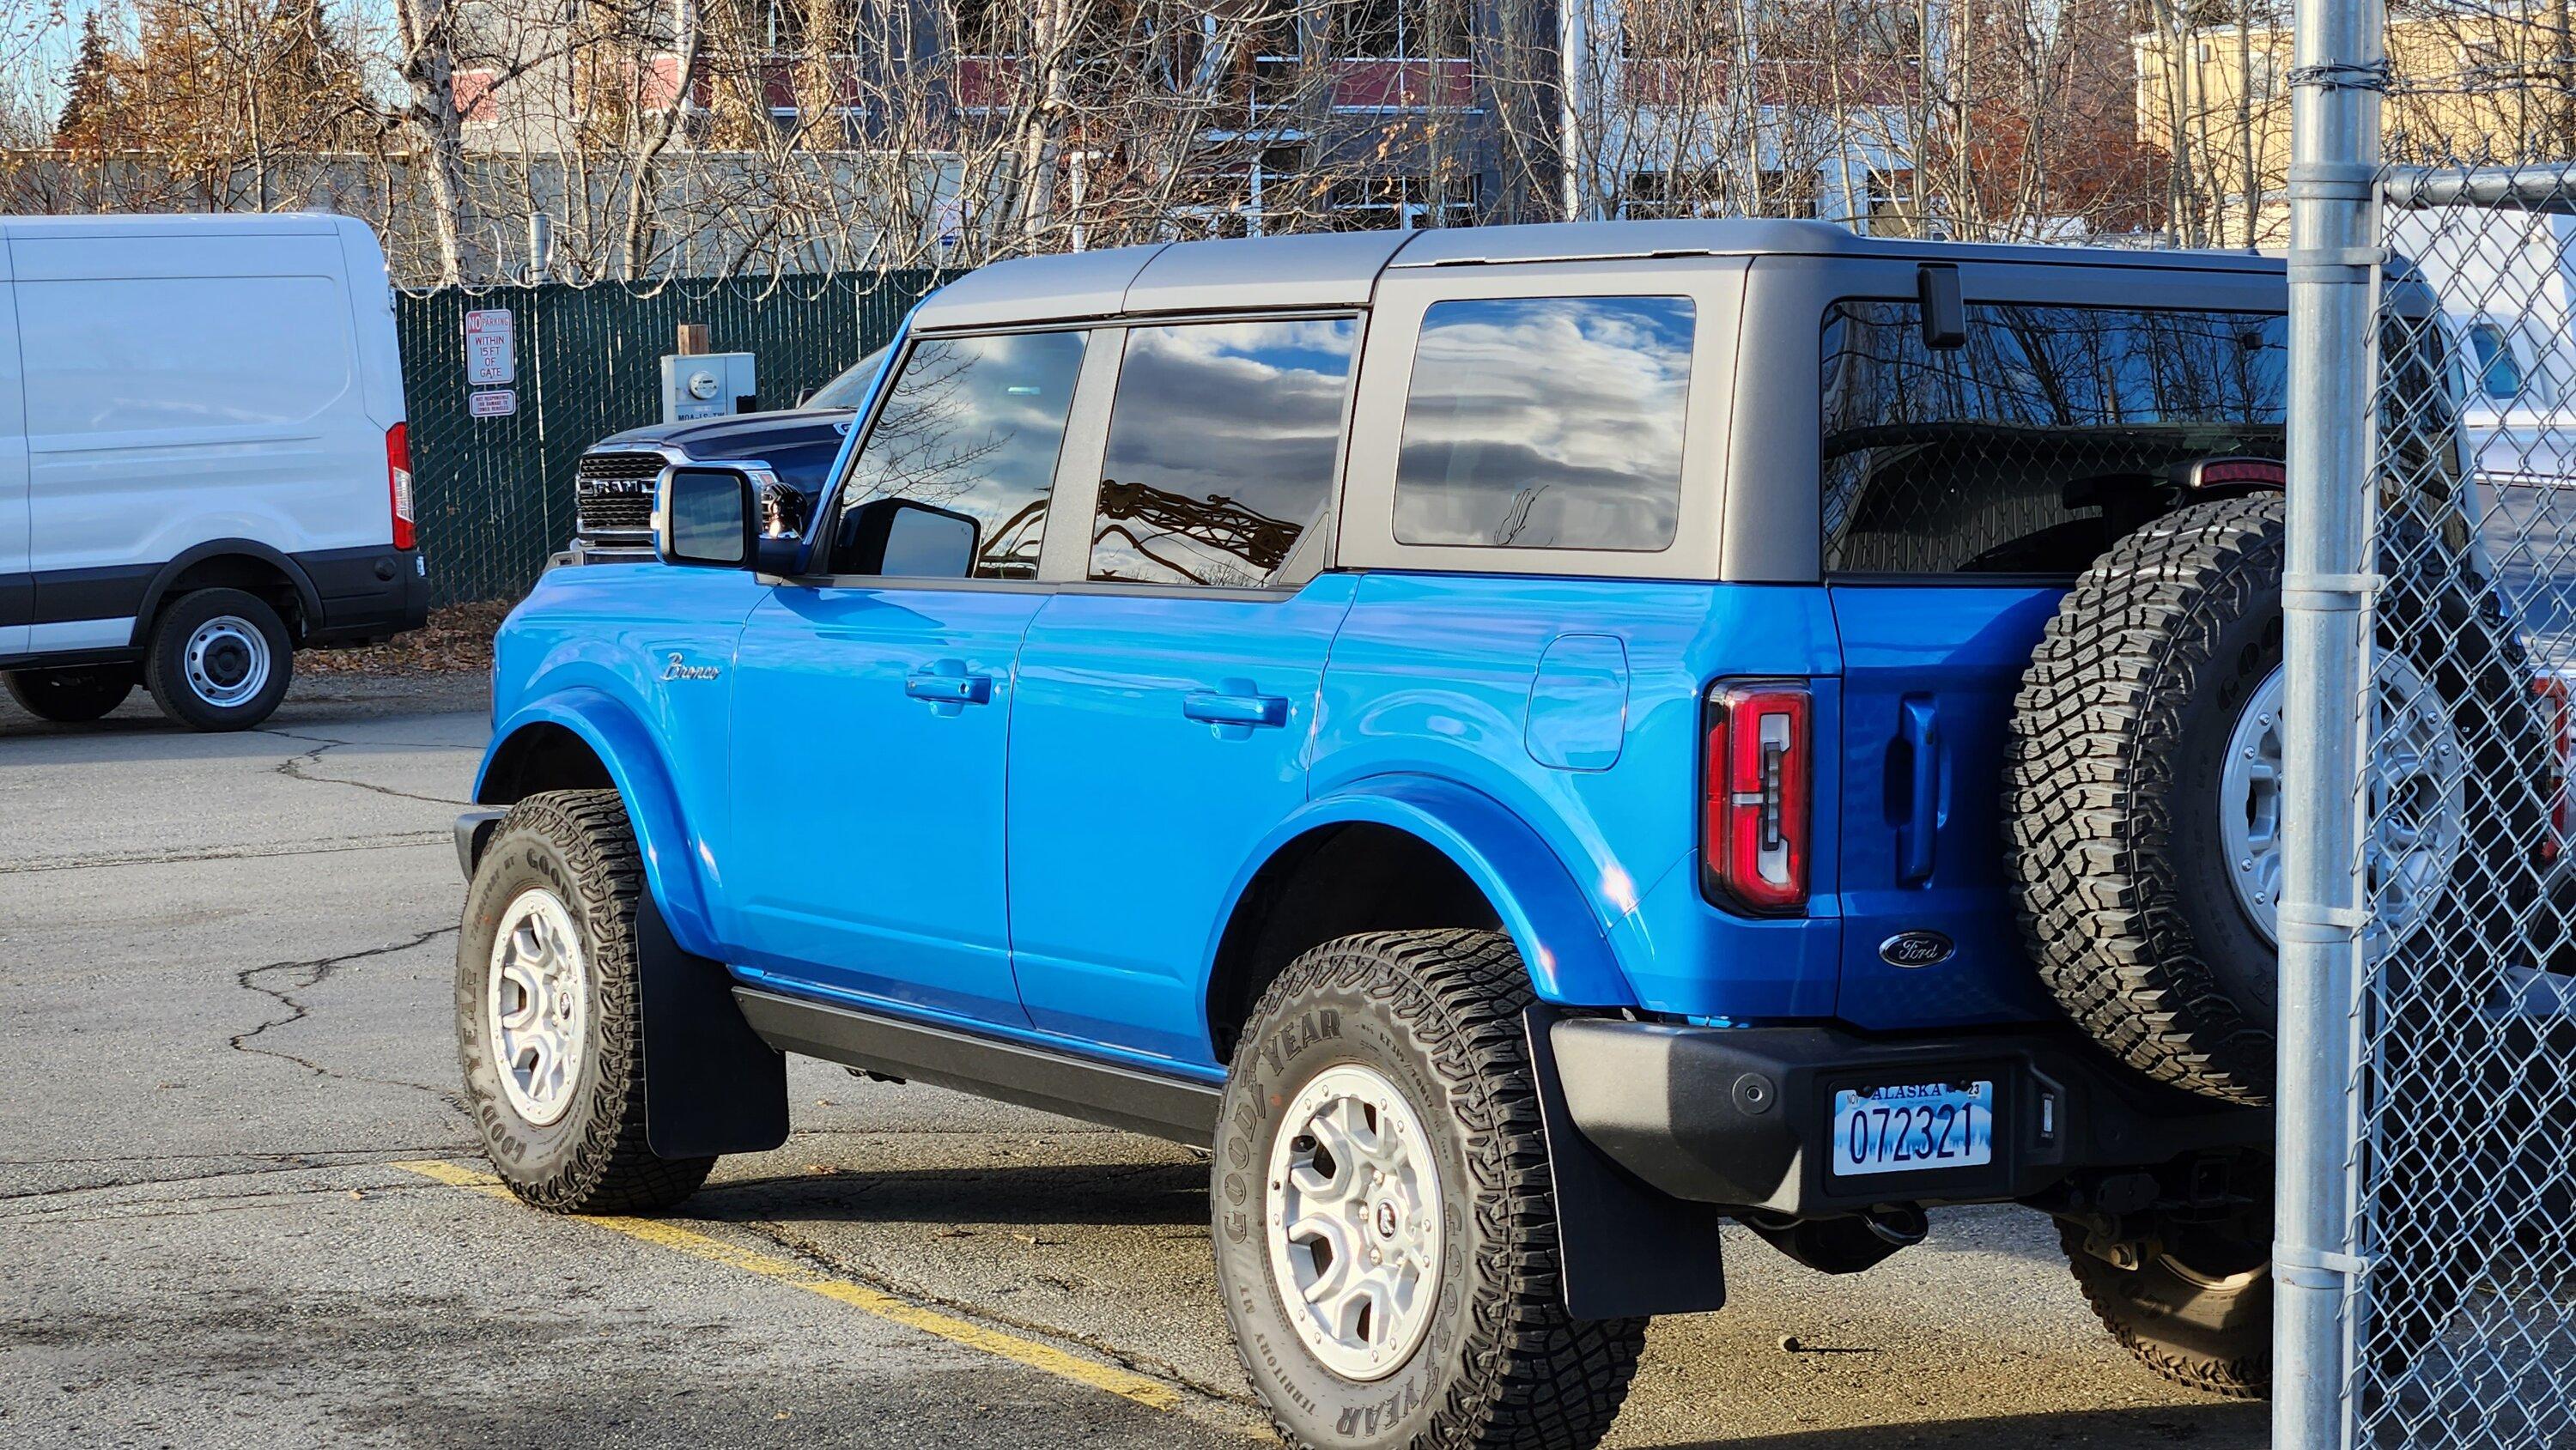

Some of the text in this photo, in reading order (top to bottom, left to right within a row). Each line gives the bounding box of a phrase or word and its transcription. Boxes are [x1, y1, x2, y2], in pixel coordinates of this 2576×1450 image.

[468, 315, 509, 331] NO PARKING
[475, 336, 505, 345] WITHIN
[480, 346, 501, 356] 15 FT
[484, 357, 496, 367] OF
[480, 367, 502, 378] GATE
[592, 480, 639, 496] RAM
[659, 652, 720, 680] Bronco
[1899, 939, 1938, 960] Ford
[1871, 1084, 1941, 1101] ALASKA
[1968, 1084, 1980, 1095] 23
[1850, 1102, 1973, 1165] 072321
[1255, 1332, 1317, 1417] TERRITORY
